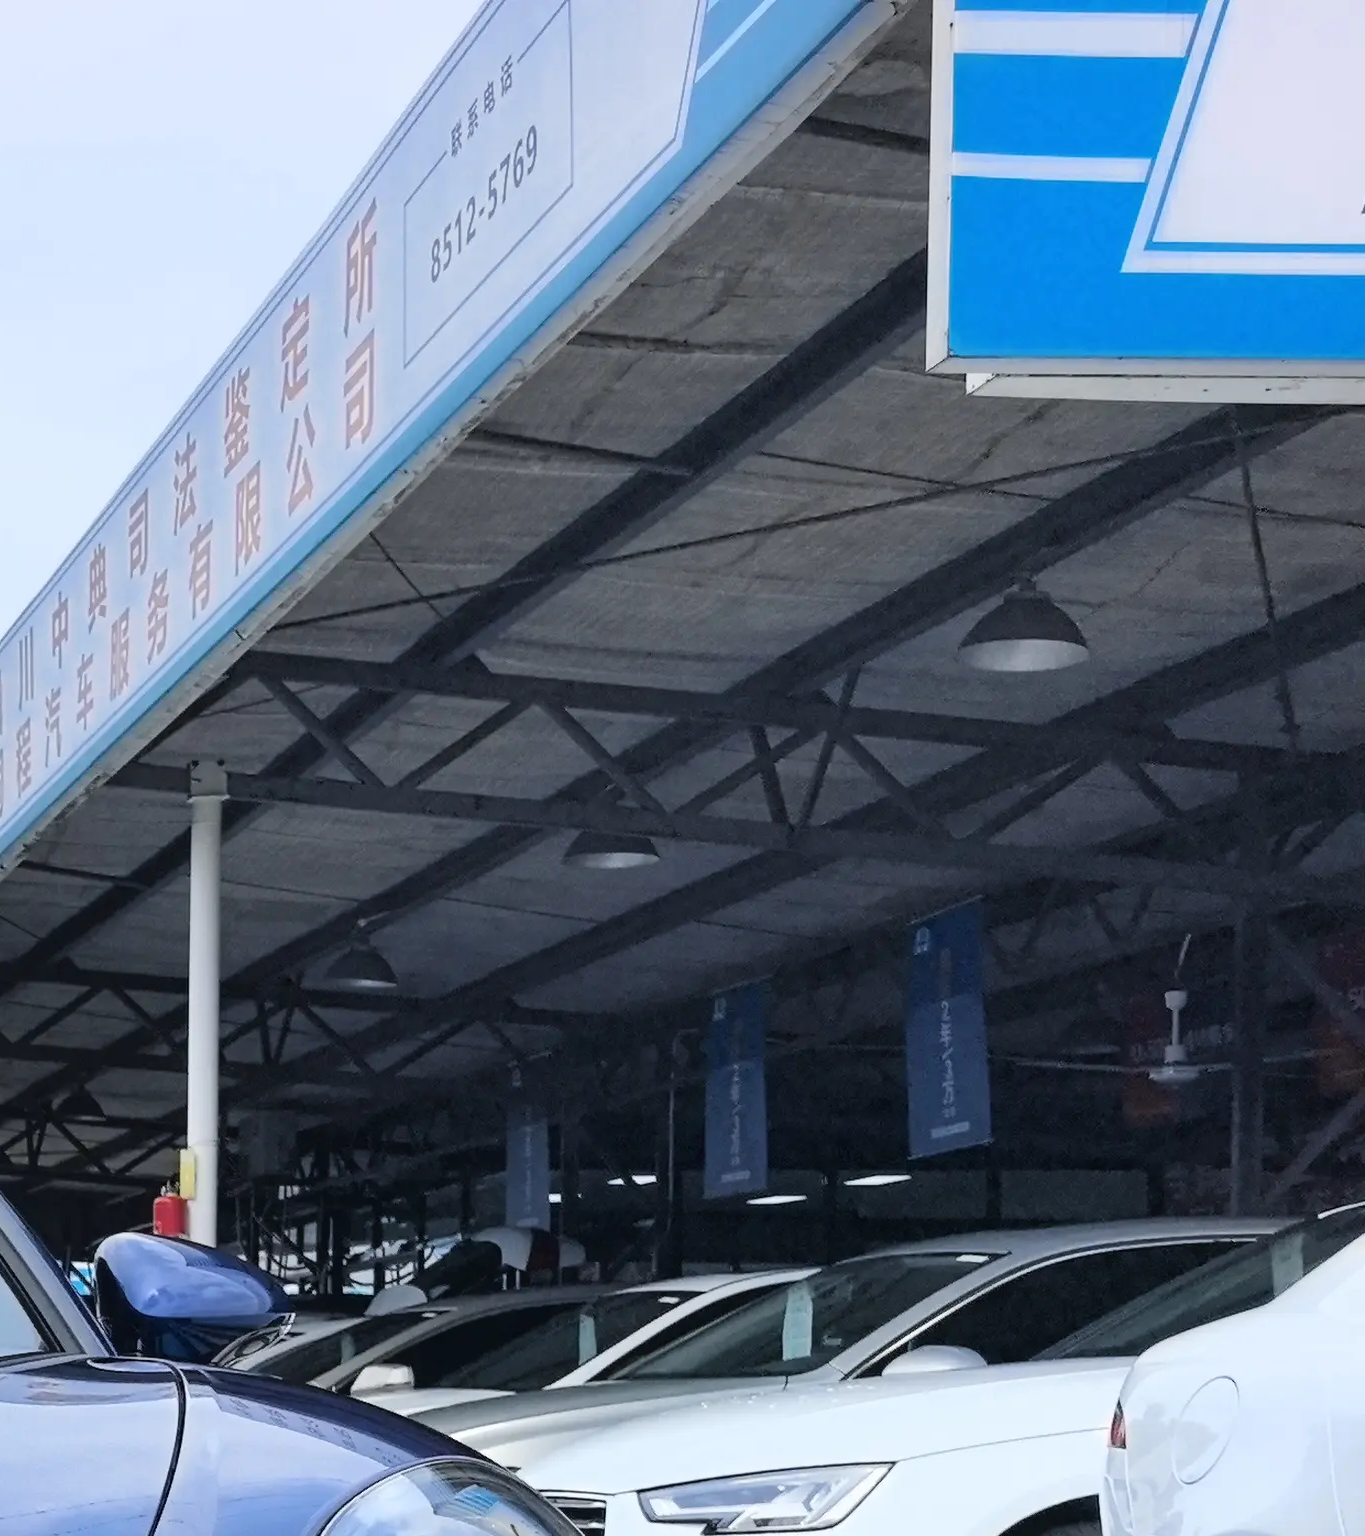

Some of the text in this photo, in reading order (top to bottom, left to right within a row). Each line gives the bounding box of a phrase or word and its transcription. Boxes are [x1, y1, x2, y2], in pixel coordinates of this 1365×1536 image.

[450, 54, 514, 158] 联系电话
[430, 124, 538, 283] 8512-5769
